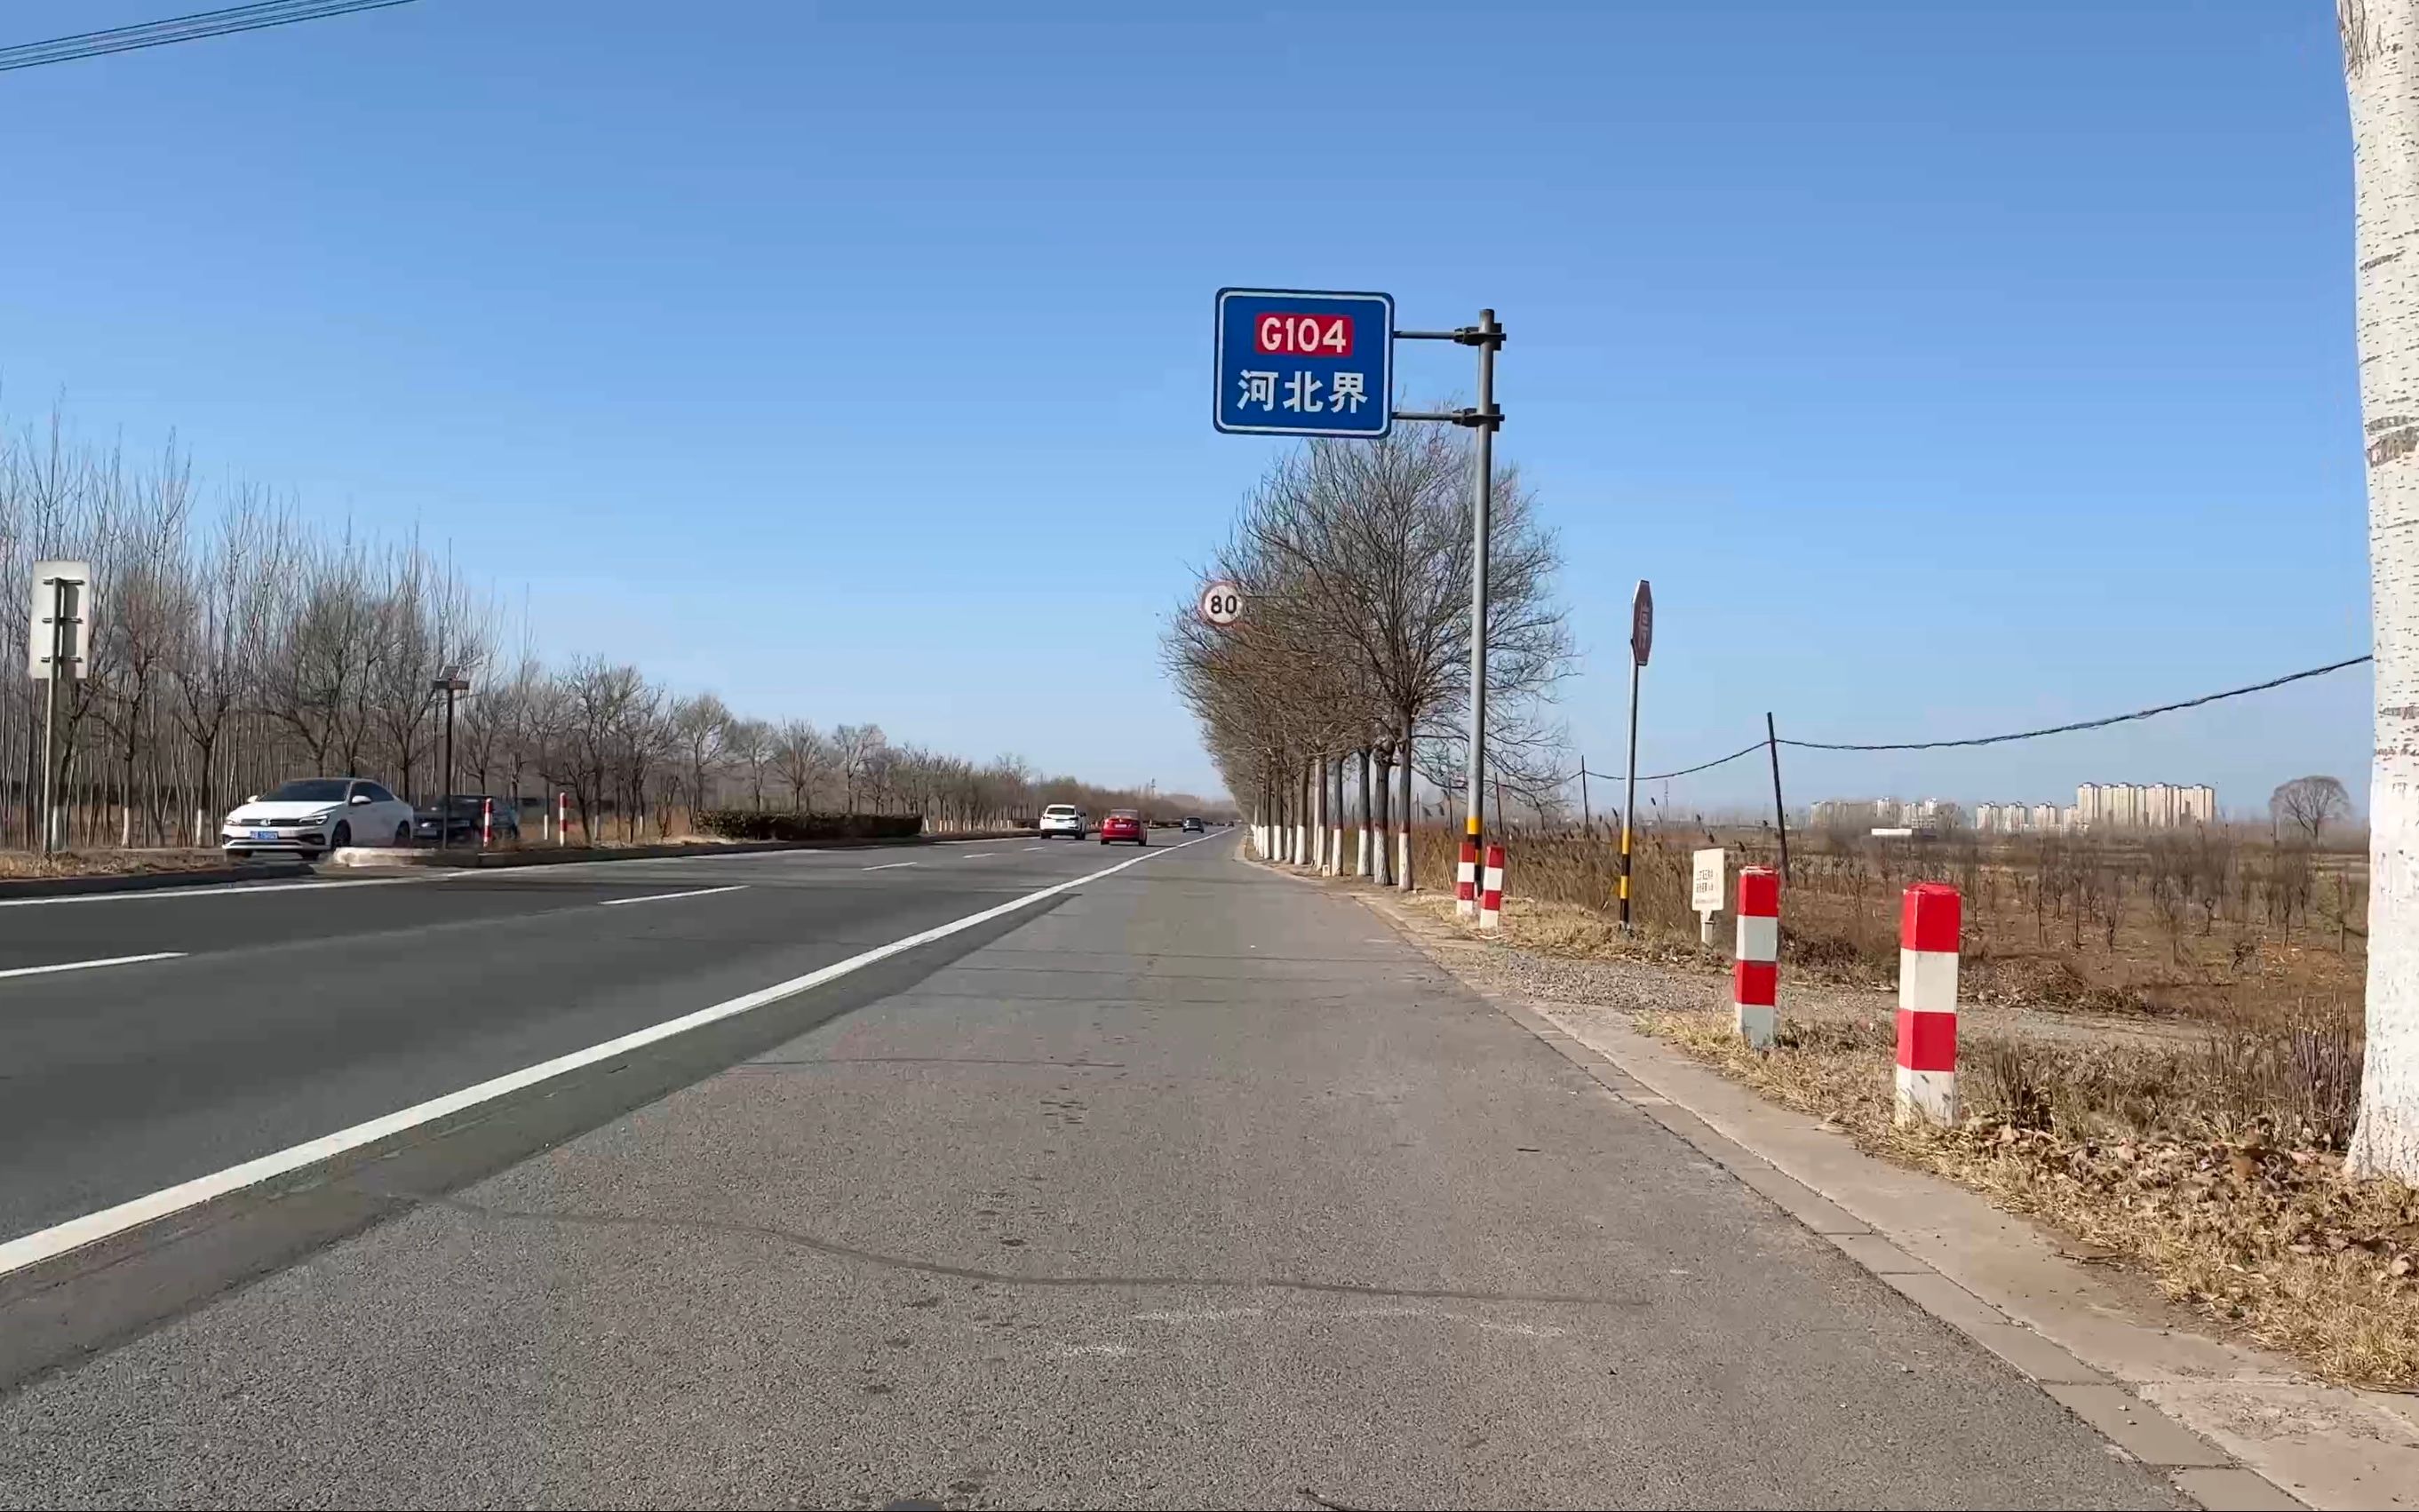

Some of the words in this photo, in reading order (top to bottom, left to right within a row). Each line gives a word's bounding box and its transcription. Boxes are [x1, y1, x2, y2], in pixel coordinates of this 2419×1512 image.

[1261, 317, 1347, 353] G104
[1236, 369, 1368, 414] 河北界
[1211, 595, 1237, 614] 80
